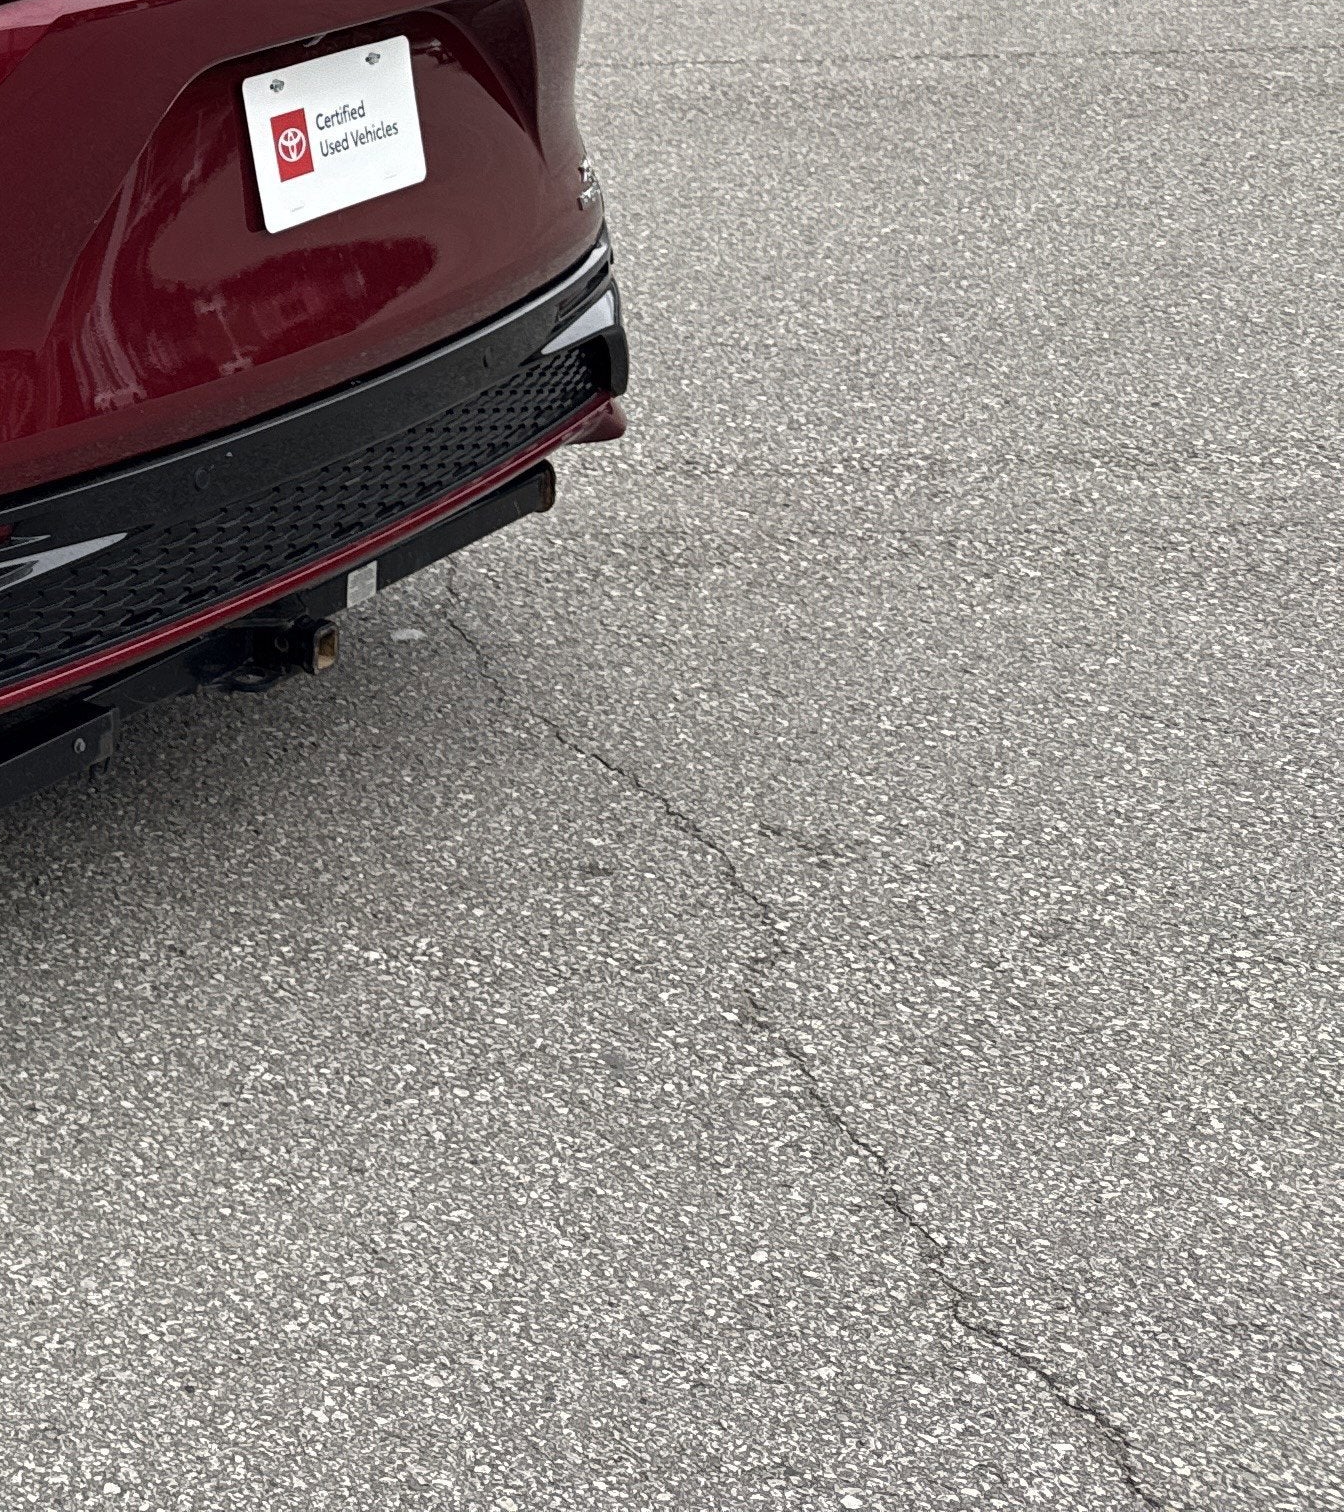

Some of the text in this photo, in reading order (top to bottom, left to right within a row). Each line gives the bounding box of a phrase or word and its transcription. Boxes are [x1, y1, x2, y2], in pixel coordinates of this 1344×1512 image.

[315, 100, 366, 131] Certified
[319, 121, 399, 157] Used Vehicles
